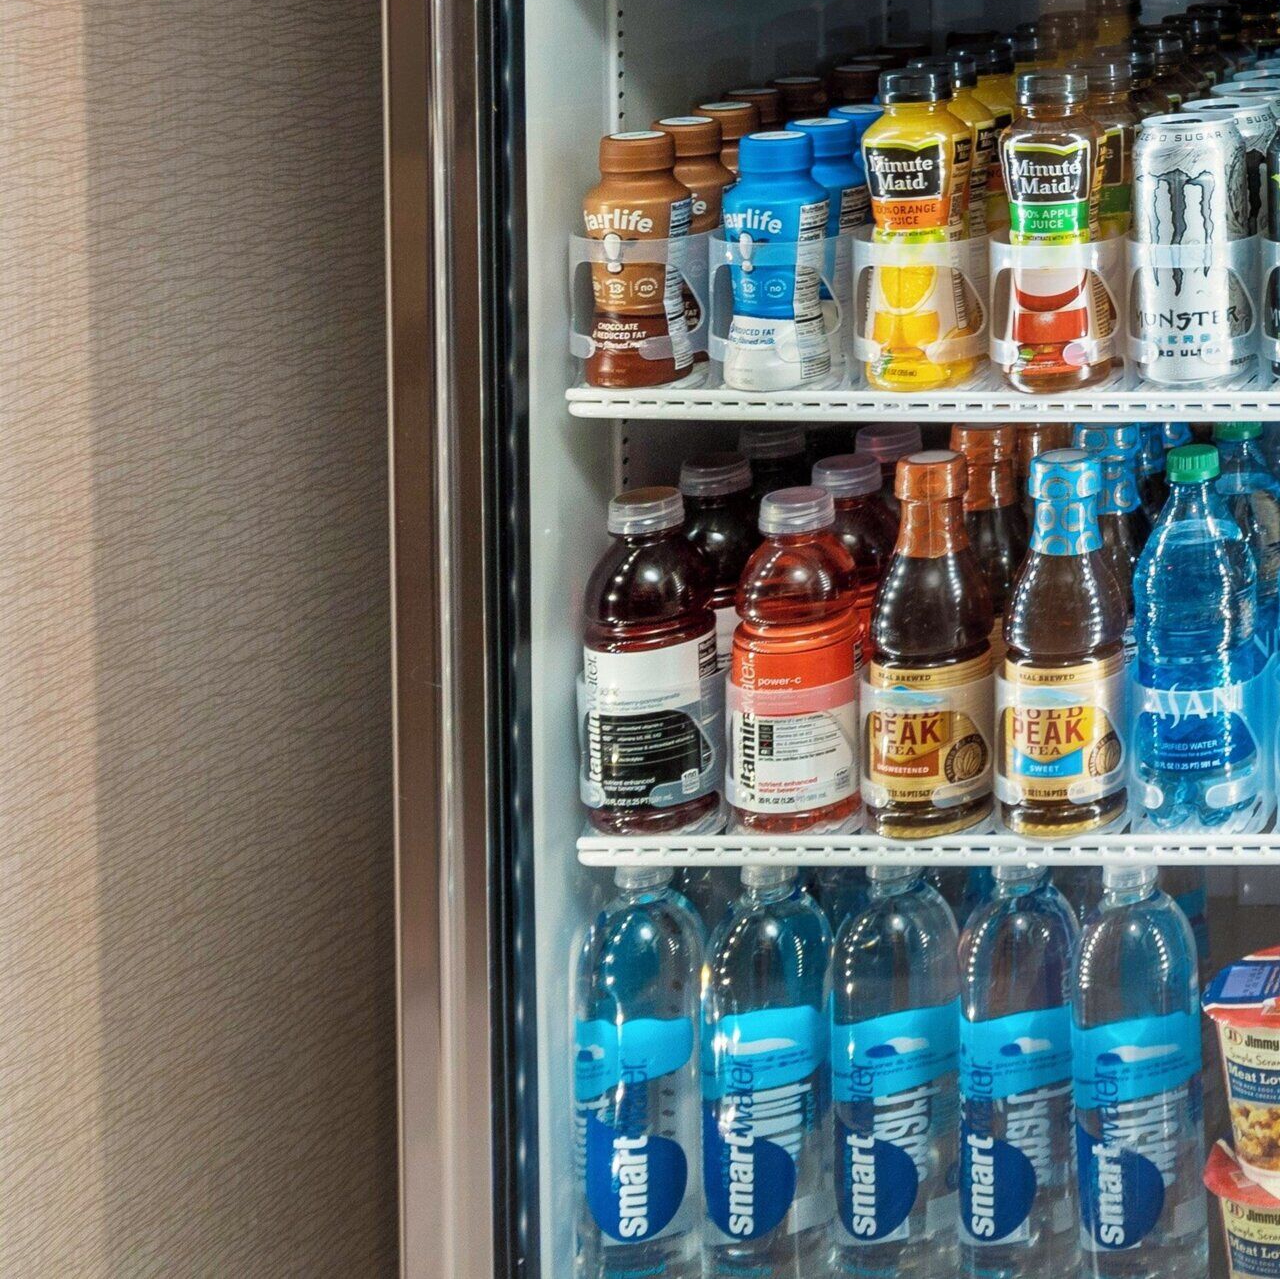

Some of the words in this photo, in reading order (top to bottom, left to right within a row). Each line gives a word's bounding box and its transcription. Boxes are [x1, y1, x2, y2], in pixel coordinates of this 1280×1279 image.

[1173, 131, 1222, 142] SUGAR
[869, 154, 933, 173] Minute
[879, 173, 925, 191] Maid
[1021, 177, 1071, 194] Maid
[893, 204, 936, 214] ORANGE
[1042, 209, 1077, 218] APPLE
[1031, 219, 1063, 228] JUICE
[598, 331, 630, 339] REDUCED
[758, 677, 801, 687] power-c
[873, 715, 942, 745] PEAK
[1012, 719, 1084, 745] PEAK
[887, 741, 916, 755] TEA
[1027, 746, 1061, 755] TEA
[1190, 740, 1218, 748] WATER
[1245, 1035, 1279, 1051] Jimmy
[614, 1135, 649, 1239] smart
[729, 1133, 754, 1237] smart
[851, 1133, 877, 1239] smart
[971, 1136, 995, 1239] smart
[1099, 1144, 1125, 1247] smart
